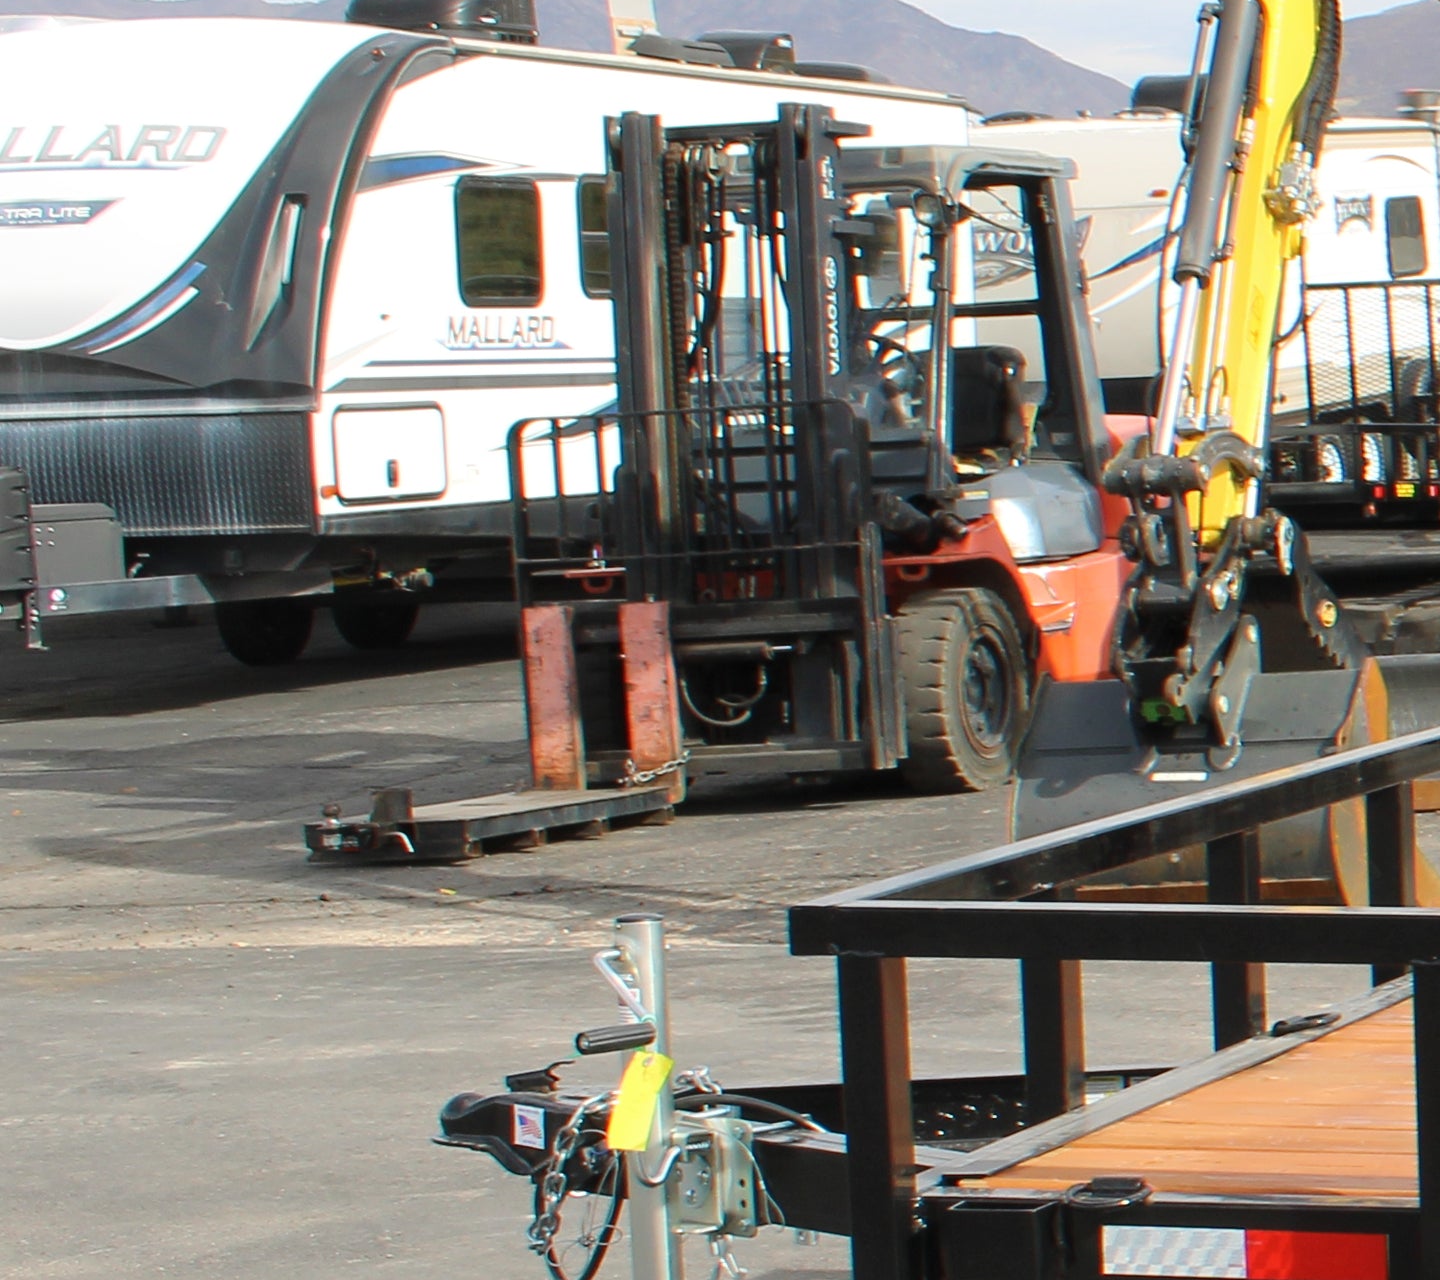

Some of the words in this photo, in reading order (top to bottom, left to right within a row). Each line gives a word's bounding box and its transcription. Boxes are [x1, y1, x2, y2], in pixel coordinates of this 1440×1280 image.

[49, 206, 91, 218] LITE
[447, 315, 556, 344] MALLARD
[826, 291, 841, 376] TOYOTA
